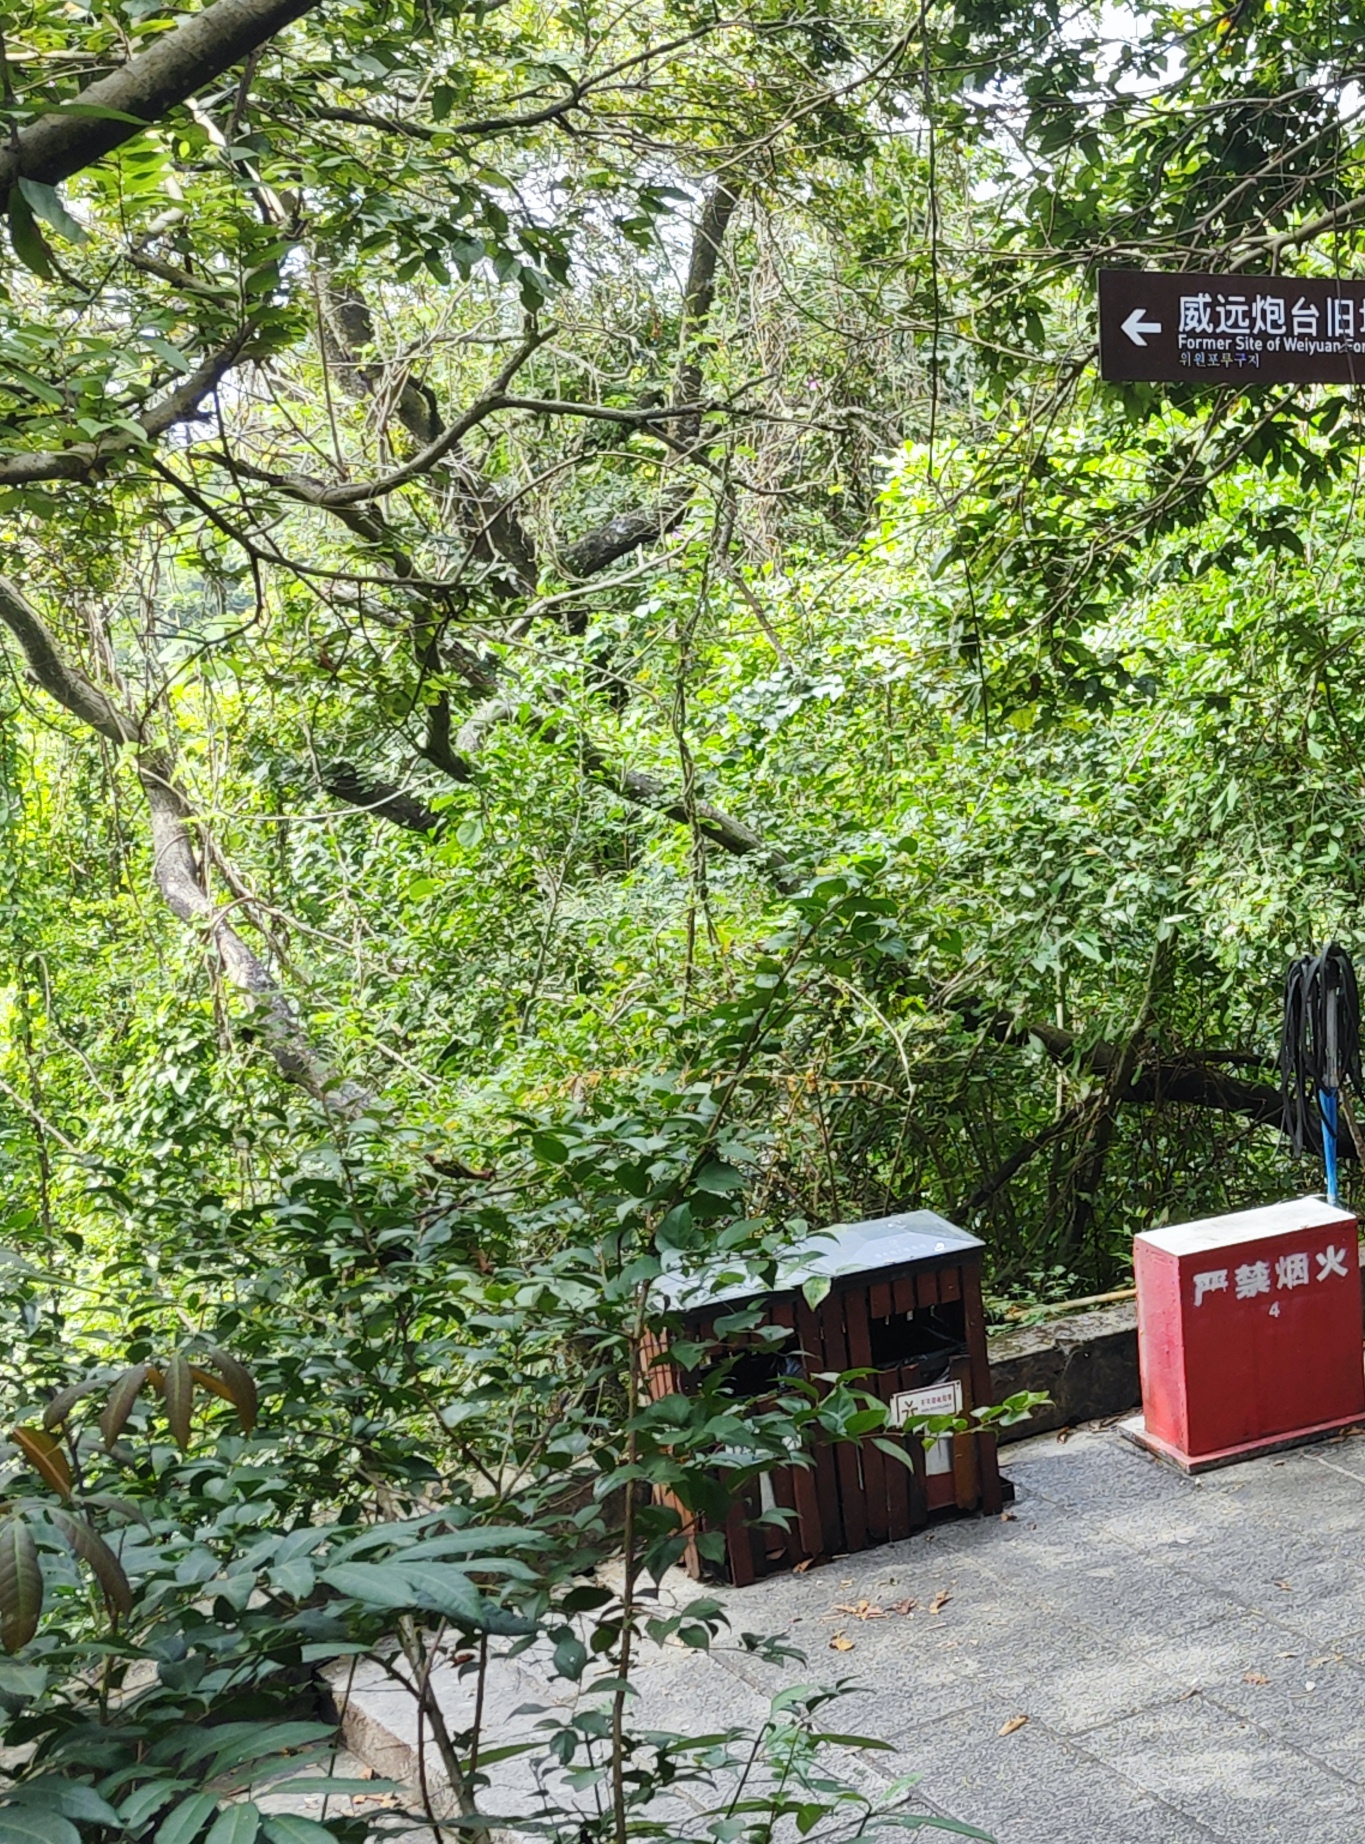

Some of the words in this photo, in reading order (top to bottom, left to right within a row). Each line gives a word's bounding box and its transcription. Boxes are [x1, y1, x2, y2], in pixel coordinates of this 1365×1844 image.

[1178, 334, 1232, 350] Former
[1235, 336, 1263, 351] Site
[1267, 337, 1280, 351] of
[1283, 338, 1341, 356] Weiyuan
[1193, 1245, 1349, 1307] 严禁烟火
[1268, 1301, 1281, 1318] 4
